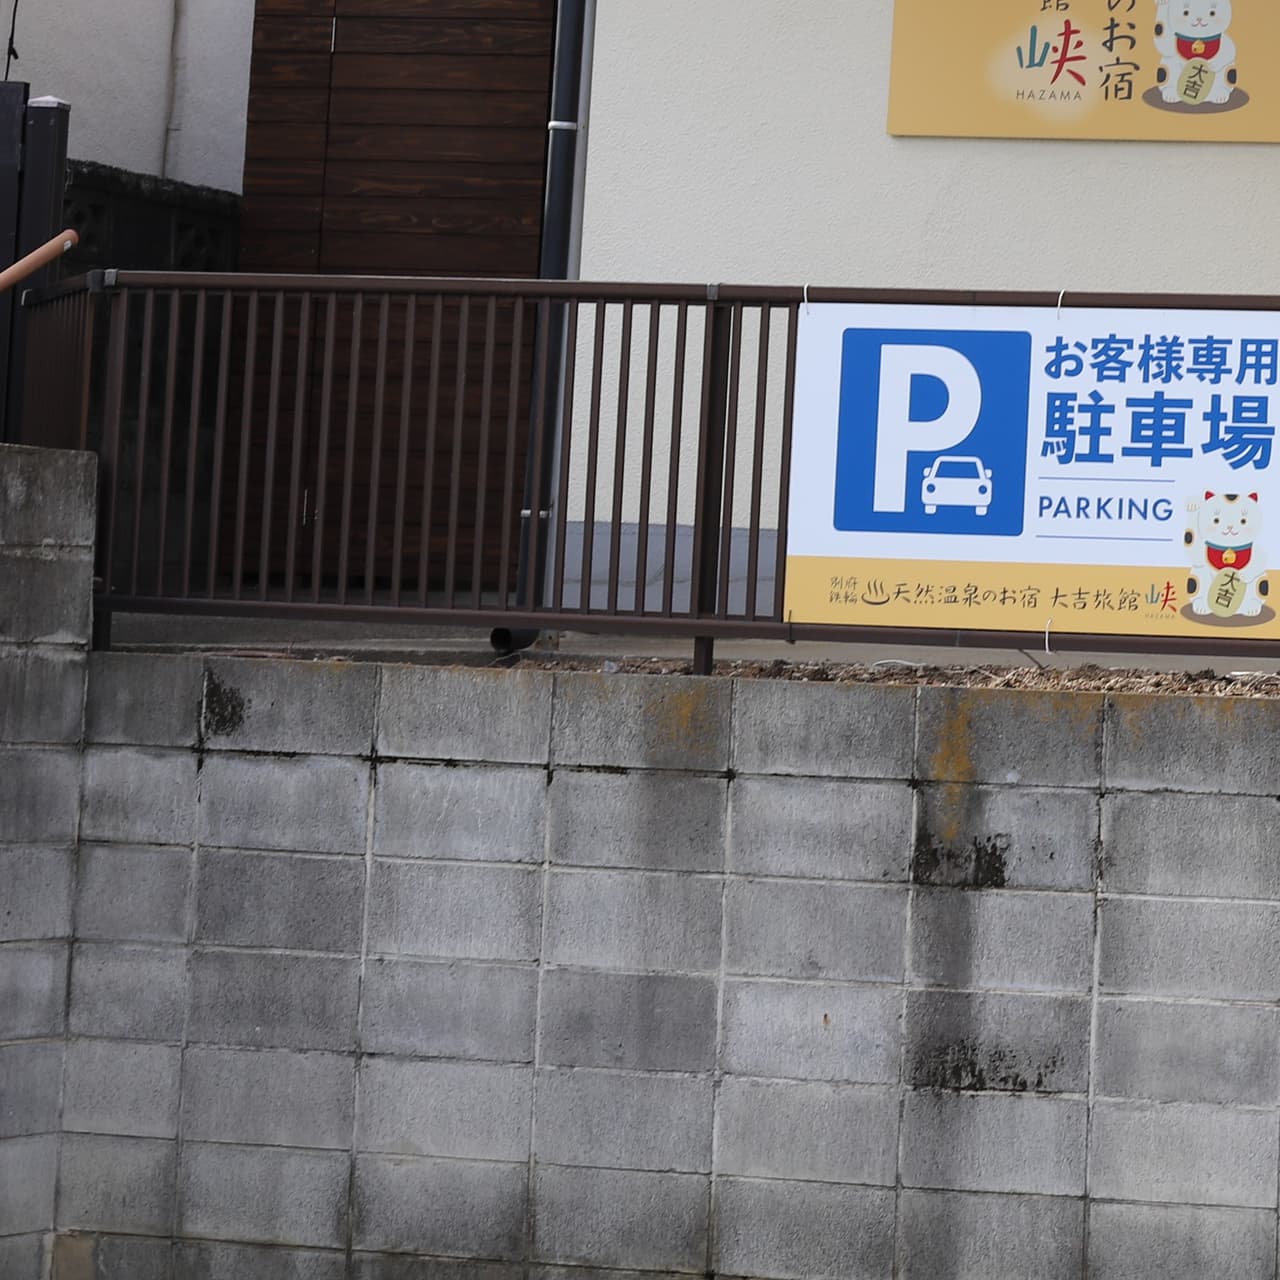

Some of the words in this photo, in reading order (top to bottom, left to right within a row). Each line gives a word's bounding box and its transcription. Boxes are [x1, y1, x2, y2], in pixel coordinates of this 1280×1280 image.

[1016, 89, 1083, 101] HAZAMA
[1182, 64, 1209, 100] 大吉
[1044, 334, 1280, 385] お客様専用
[873, 344, 982, 513] P
[1040, 390, 1276, 470] 駐車場
[1039, 496, 1174, 521] PARKING
[892, 583, 1041, 609] 天然温泉のお宿
[1050, 587, 1141, 611] 大吉旅館
[1215, 571, 1238, 608] 大吉
